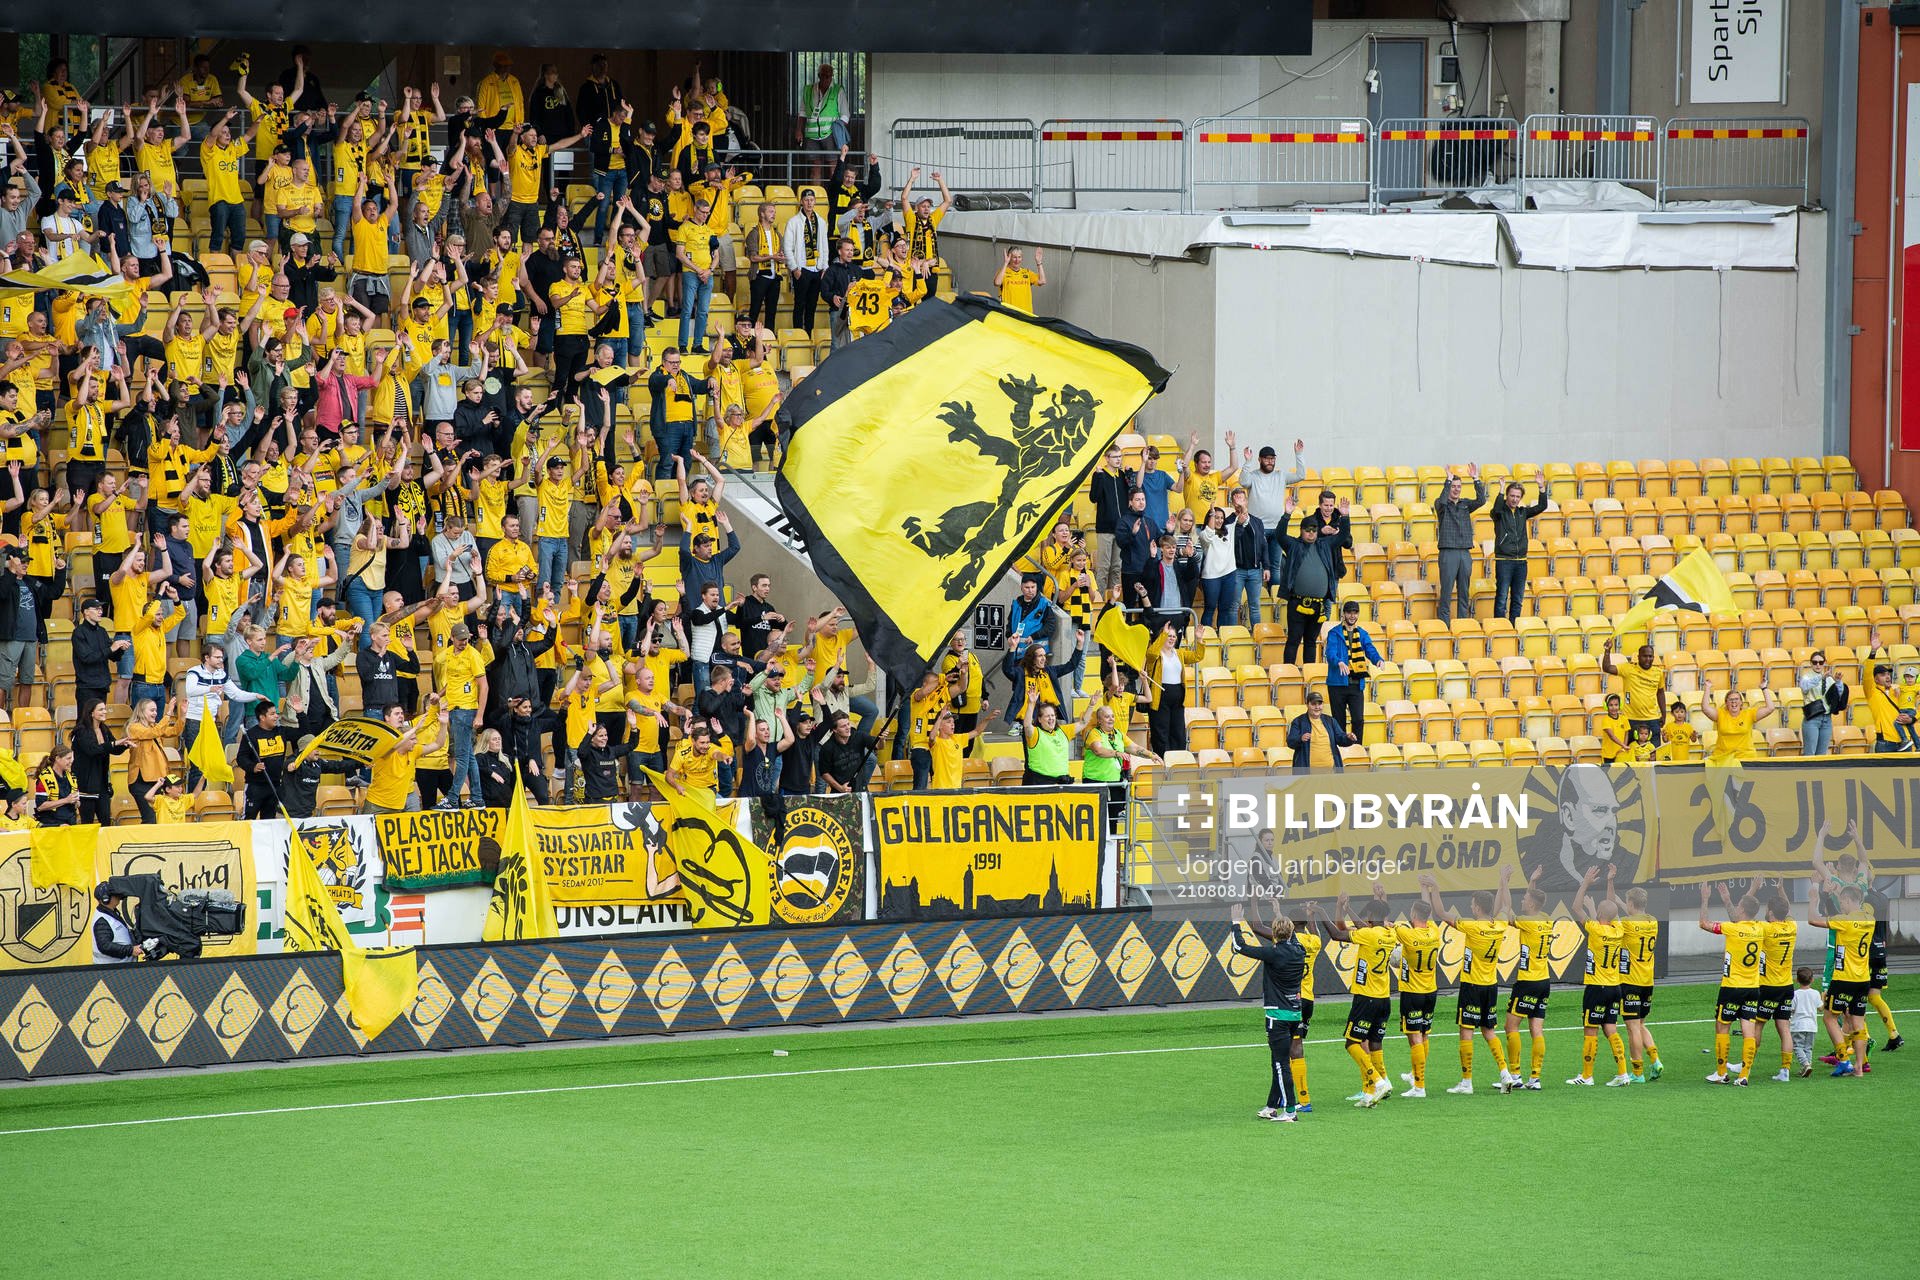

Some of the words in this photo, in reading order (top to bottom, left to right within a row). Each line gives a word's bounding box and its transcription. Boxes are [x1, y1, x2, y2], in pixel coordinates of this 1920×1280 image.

[856, 293, 880, 316] 43
[881, 803, 1095, 845] GULIGANERNA
[387, 846, 423, 877] NEJ
[428, 841, 477, 872] TACK
[543, 854, 625, 876] SYSTRAR
[973, 853, 1001, 870] 1991
[1396, 834, 1502, 872] GLÖMD
[562, 879, 585, 888] SEDAN
[1484, 939, 1497, 963] 4
[1636, 936, 1656, 962] 19
[1742, 941, 1759, 967] 8
[1779, 941, 1791, 966] 7
[1858, 932, 1869, 958] 6
[1414, 948, 1438, 973] 10
